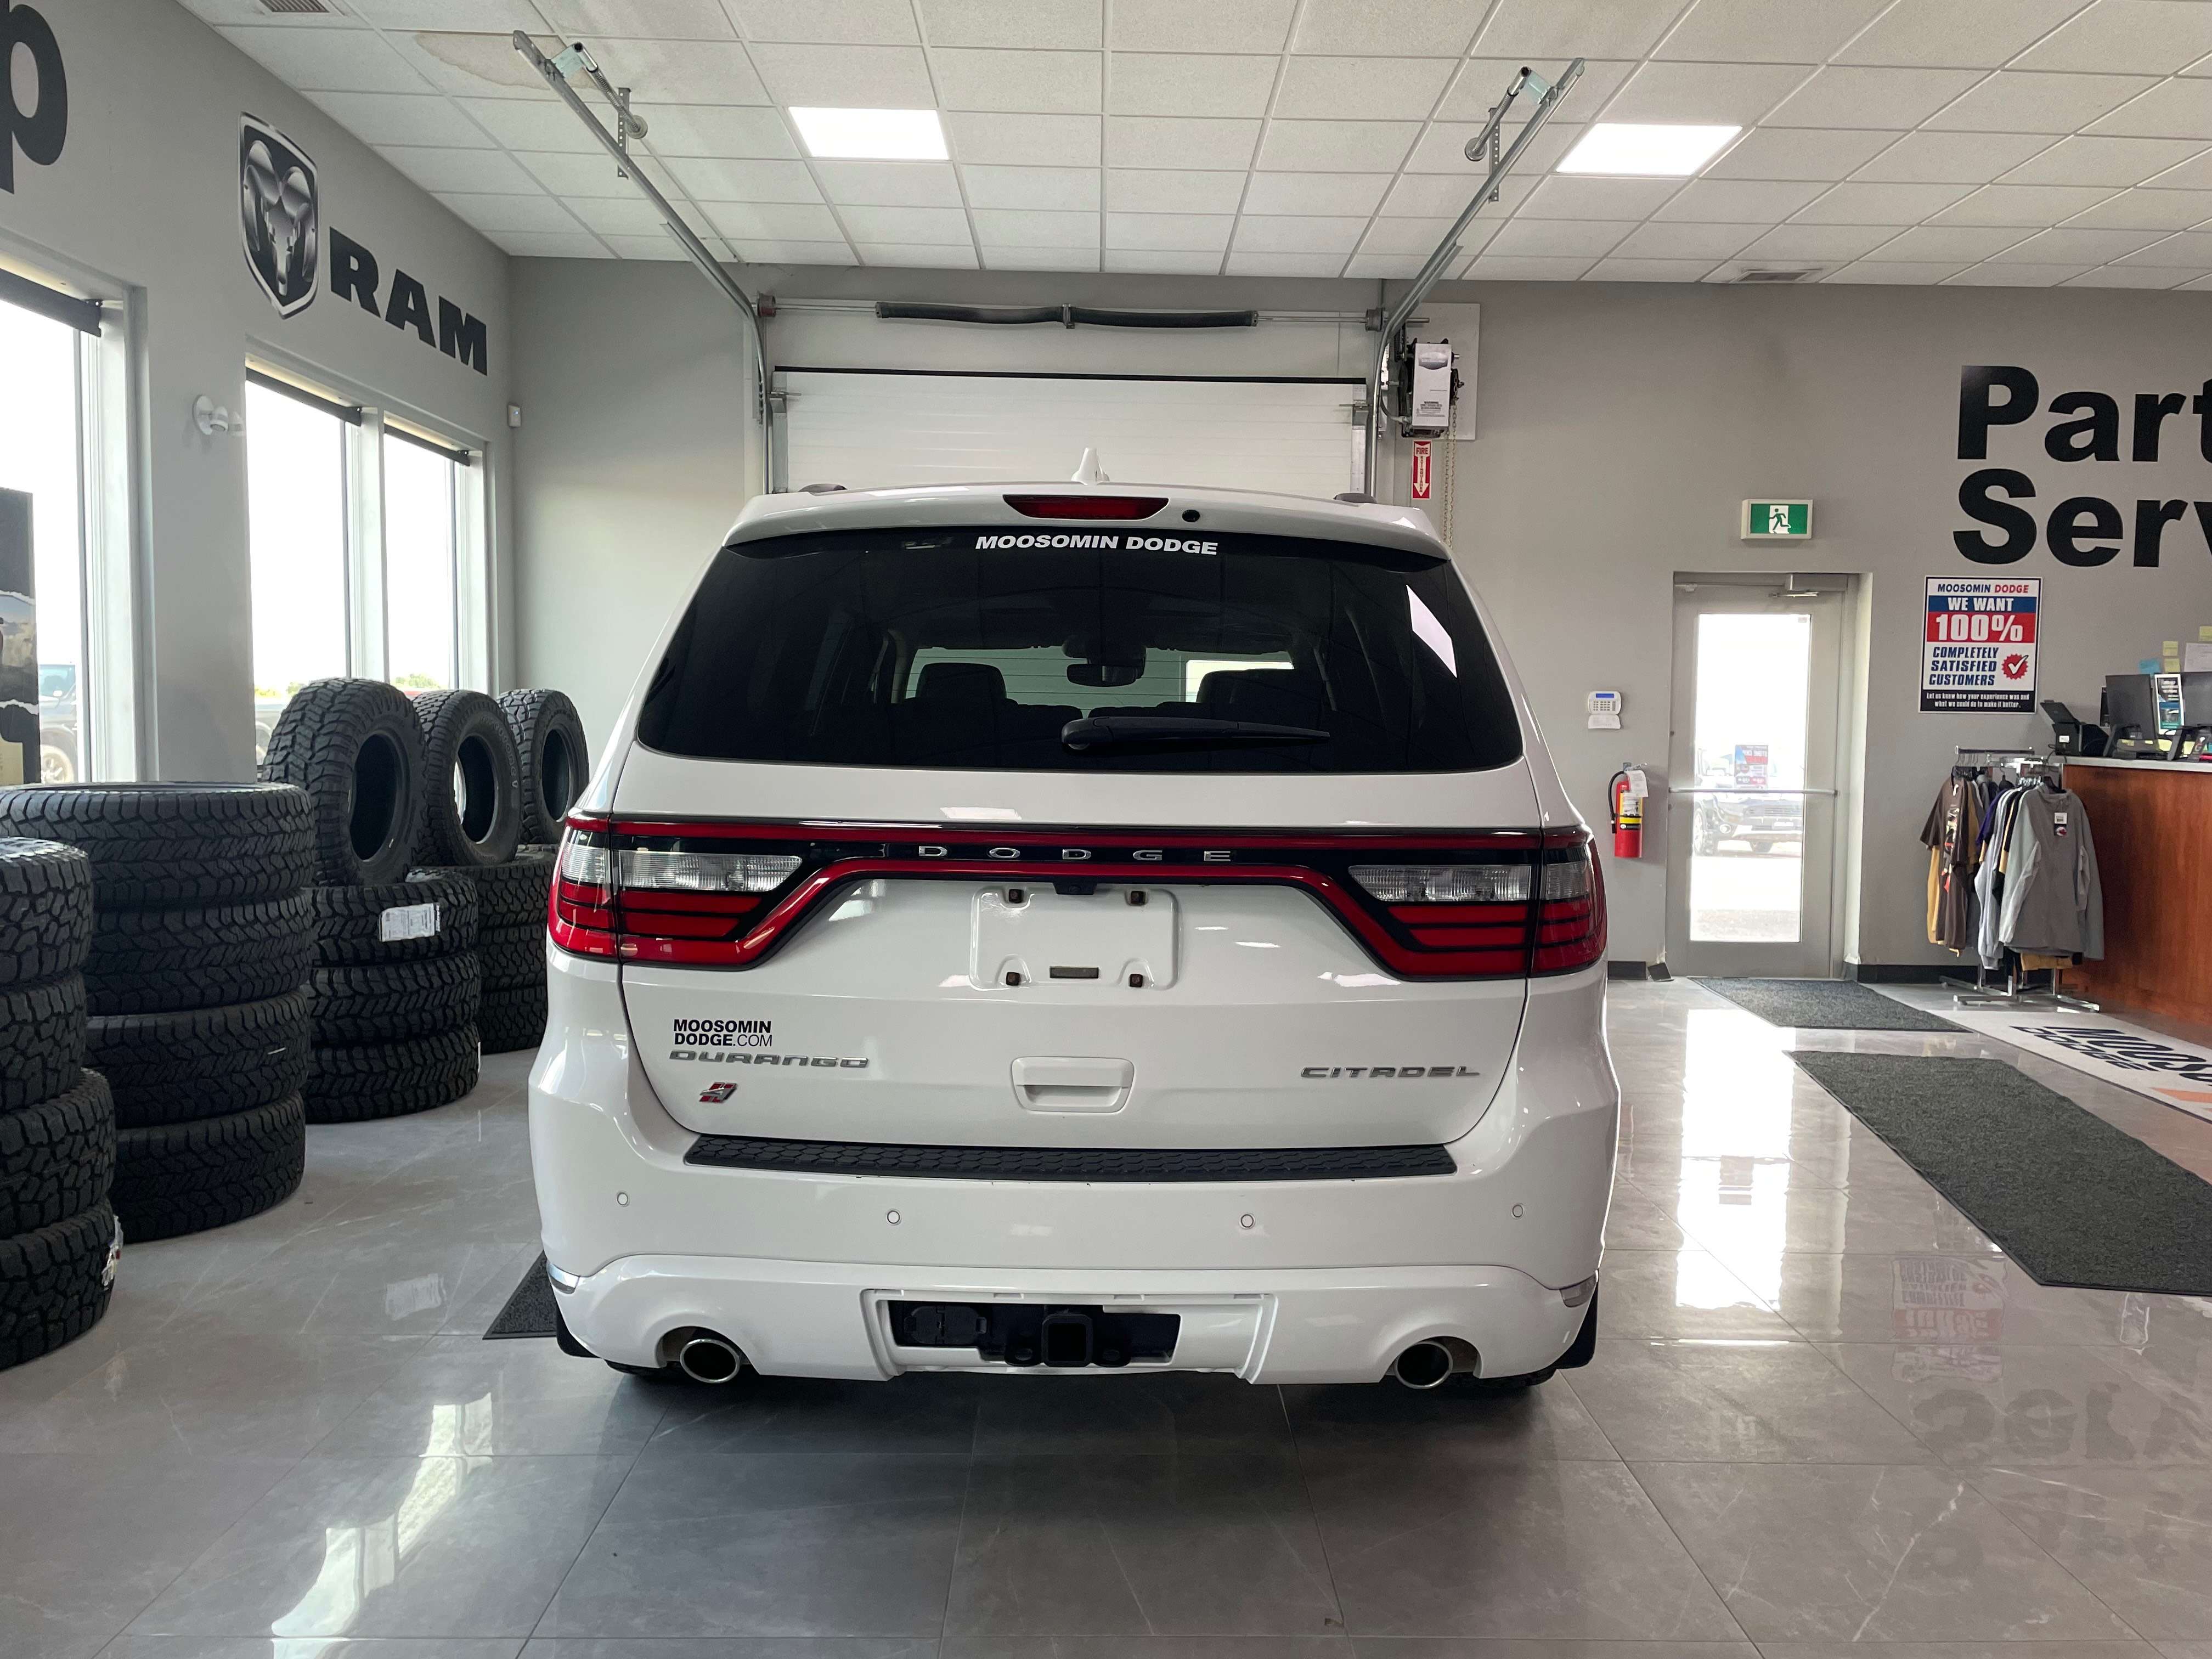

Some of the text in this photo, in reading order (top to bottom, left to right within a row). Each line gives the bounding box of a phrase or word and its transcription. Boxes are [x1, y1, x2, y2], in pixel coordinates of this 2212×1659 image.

[329, 227, 488, 376] RAM
[1953, 468, 2212, 568] Ser
[975, 535, 1218, 555] MOOSOMIN DODGE
[1937, 584, 2029, 594] MOOSOMIN DODGE
[1948, 597, 2014, 611] WE WANT
[1936, 614, 2023, 641] 100%
[1933, 647, 1999, 658] COMPLETELY
[1931, 660, 1997, 672] SATISFIED
[1929, 674, 1995, 686] CUSTOMERS
[918, 845, 1232, 862] DODGE
[673, 1019, 772, 1034] MOOSOMIN
[674, 1032, 772, 1047] DODGE.COM
[669, 1049, 870, 1068] DURANGO
[1300, 1066, 1480, 1079] CITADEL
